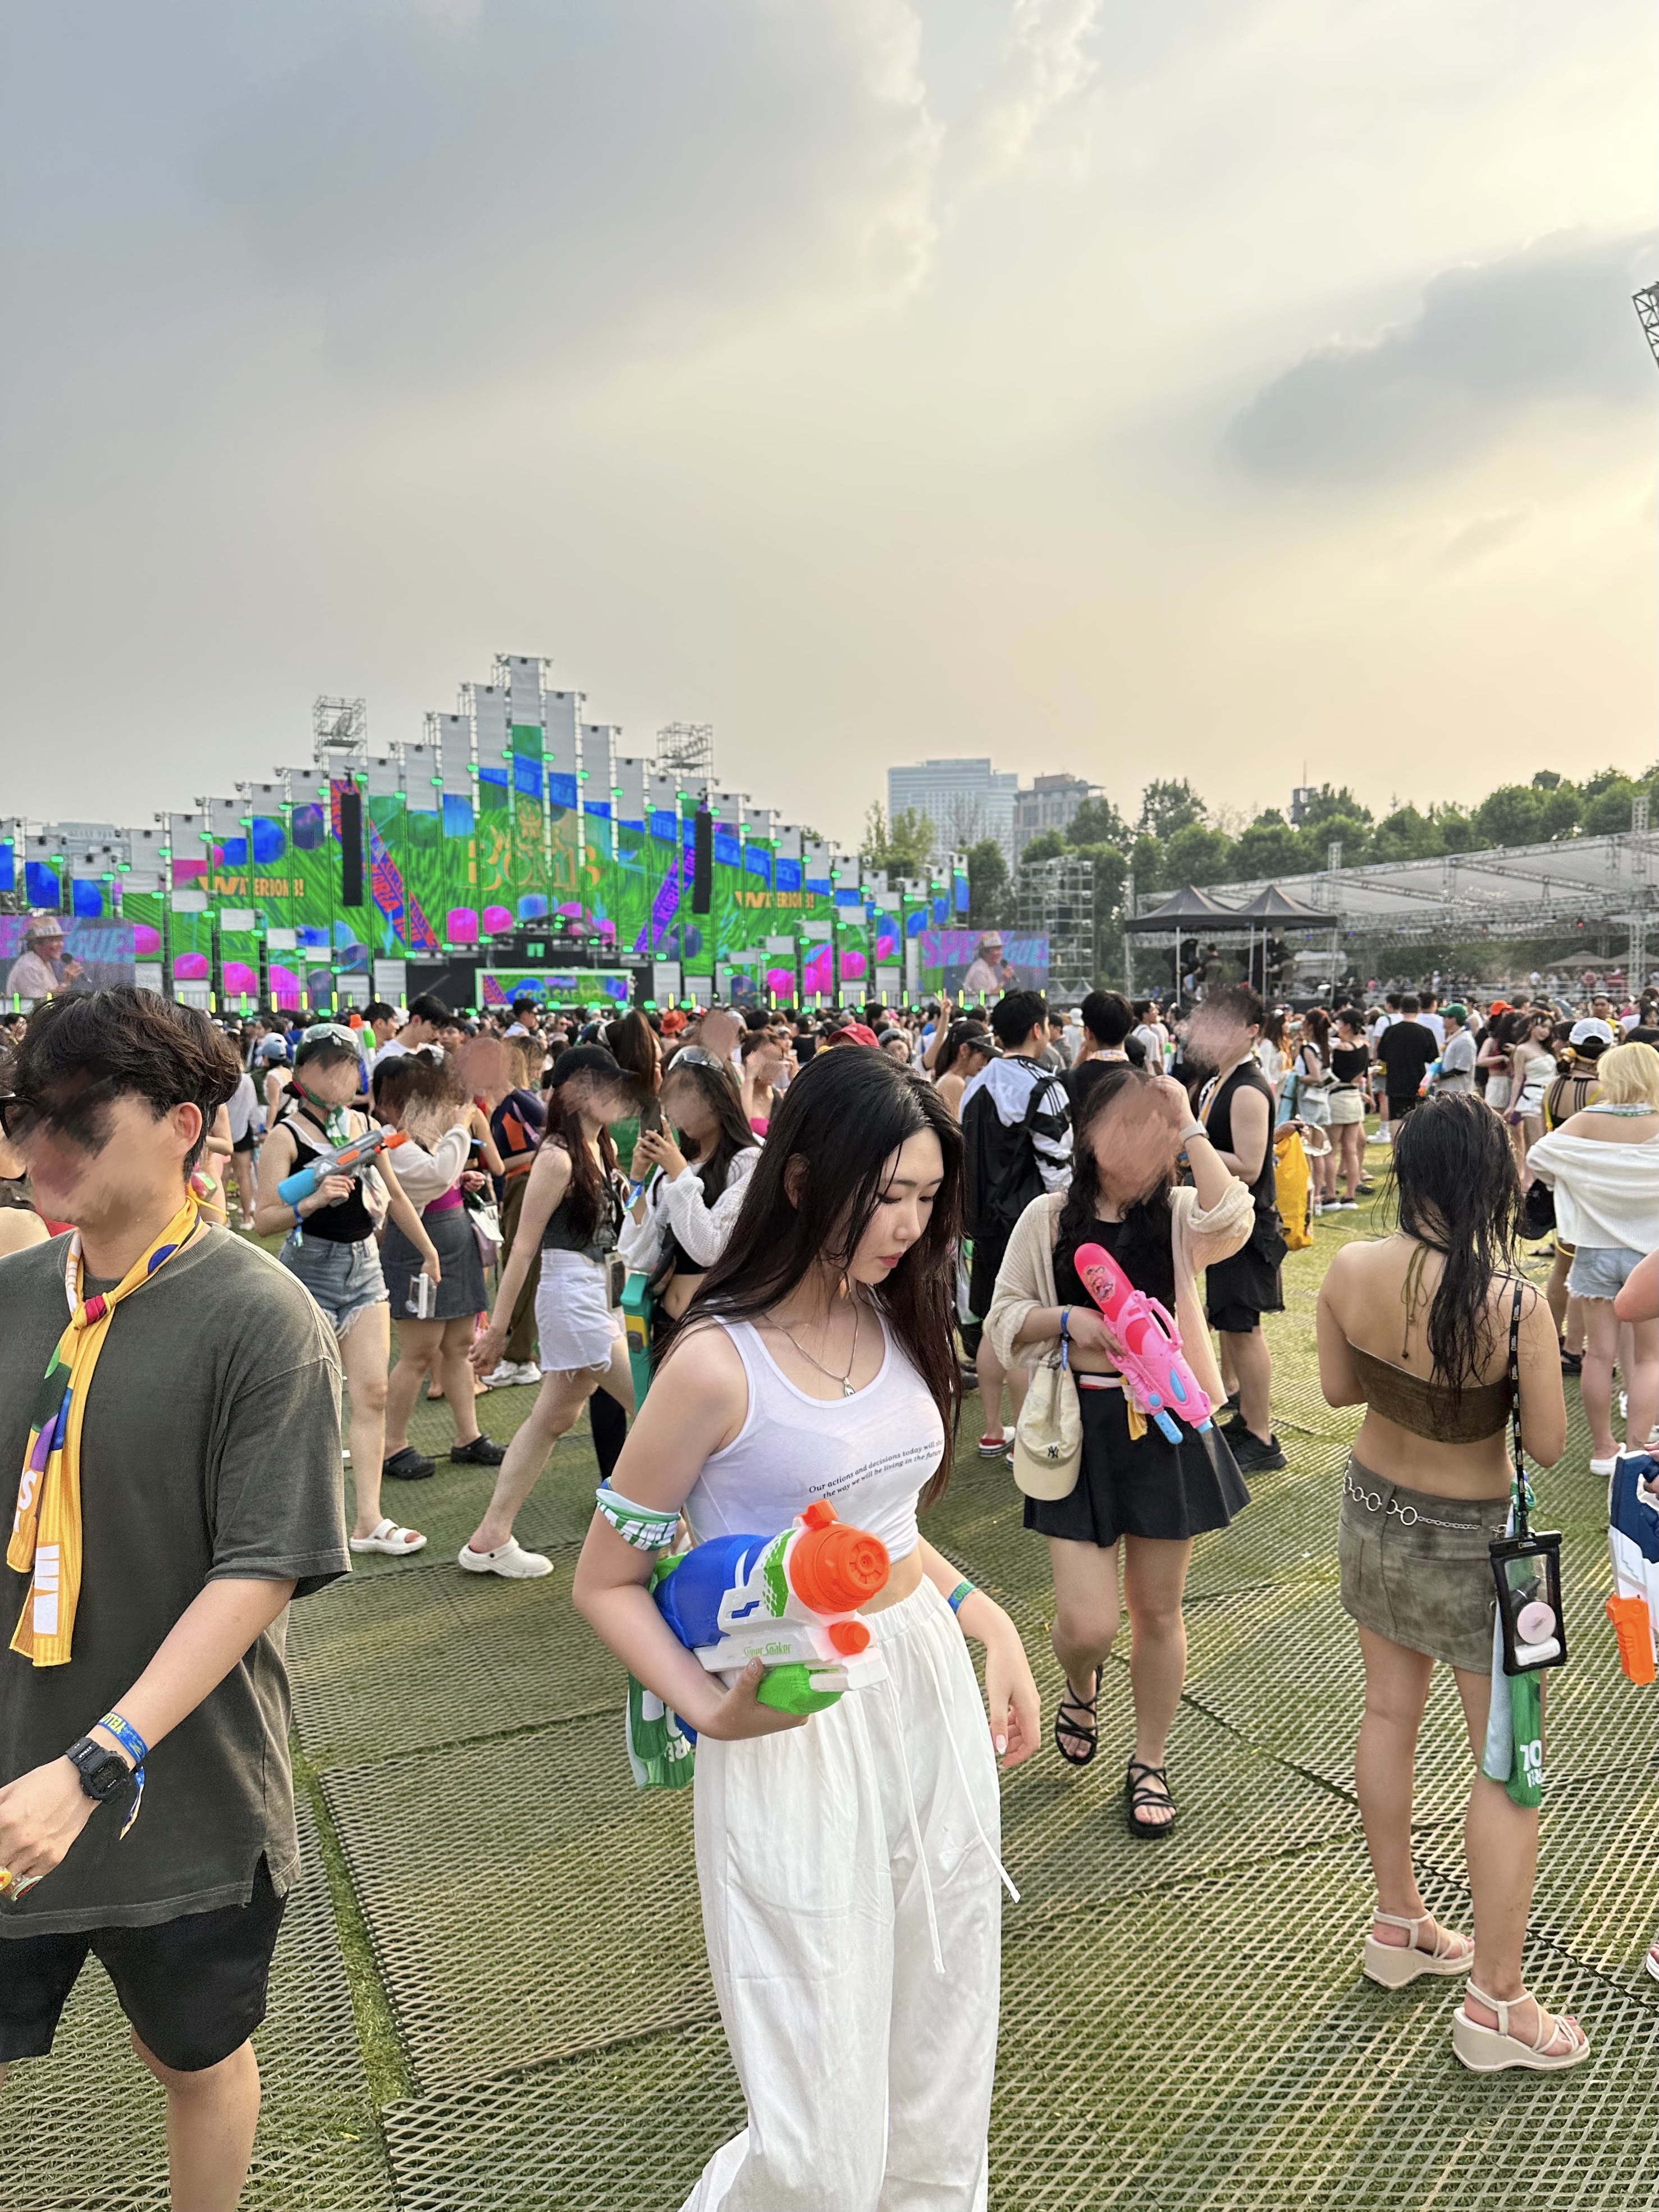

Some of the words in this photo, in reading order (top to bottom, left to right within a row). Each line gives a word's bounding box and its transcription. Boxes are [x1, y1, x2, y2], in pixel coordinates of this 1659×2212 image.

[809, 1483, 826, 1493] Our
[828, 1473, 854, 1487] actions
[855, 1464, 868, 1475] and
[869, 1453, 901, 1469] decisions
[902, 1447, 922, 1457] today
[924, 1441, 935, 1450] will
[1048, 1446, 1059, 1459] NY
[823, 1489, 836, 1499] the
[837, 1483, 851, 1493] way
[861, 1470, 872, 1480] will
[874, 1467, 883, 1475] be
[884, 1459, 903, 1471] living
